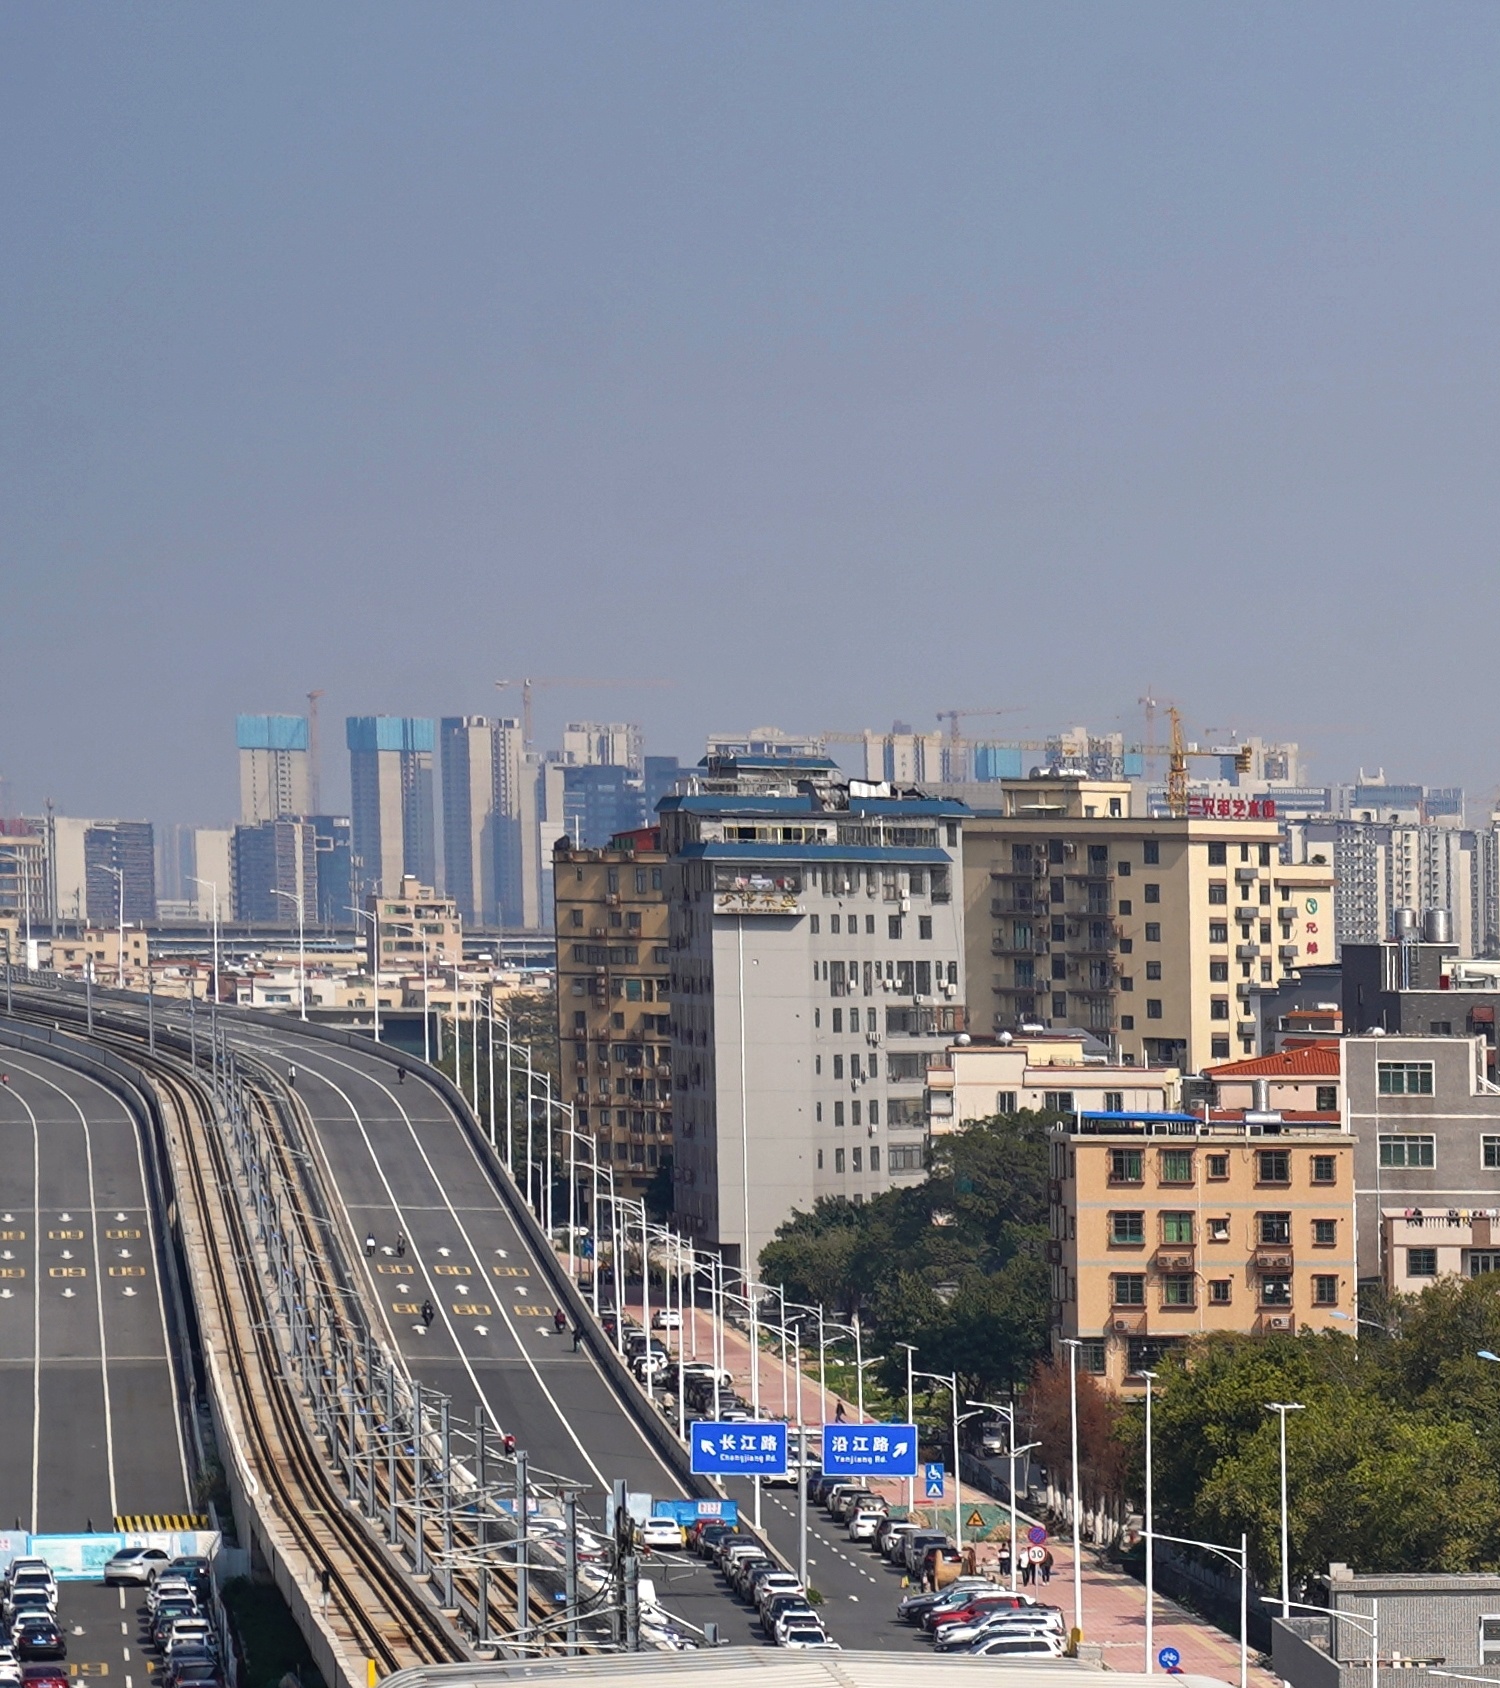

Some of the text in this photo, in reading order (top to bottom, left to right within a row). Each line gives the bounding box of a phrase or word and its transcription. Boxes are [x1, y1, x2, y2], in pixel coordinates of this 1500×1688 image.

[719, 1434, 778, 1451] 长江路
[832, 1436, 889, 1453] 沿江路
[1031, 1550, 1043, 1560] 30
